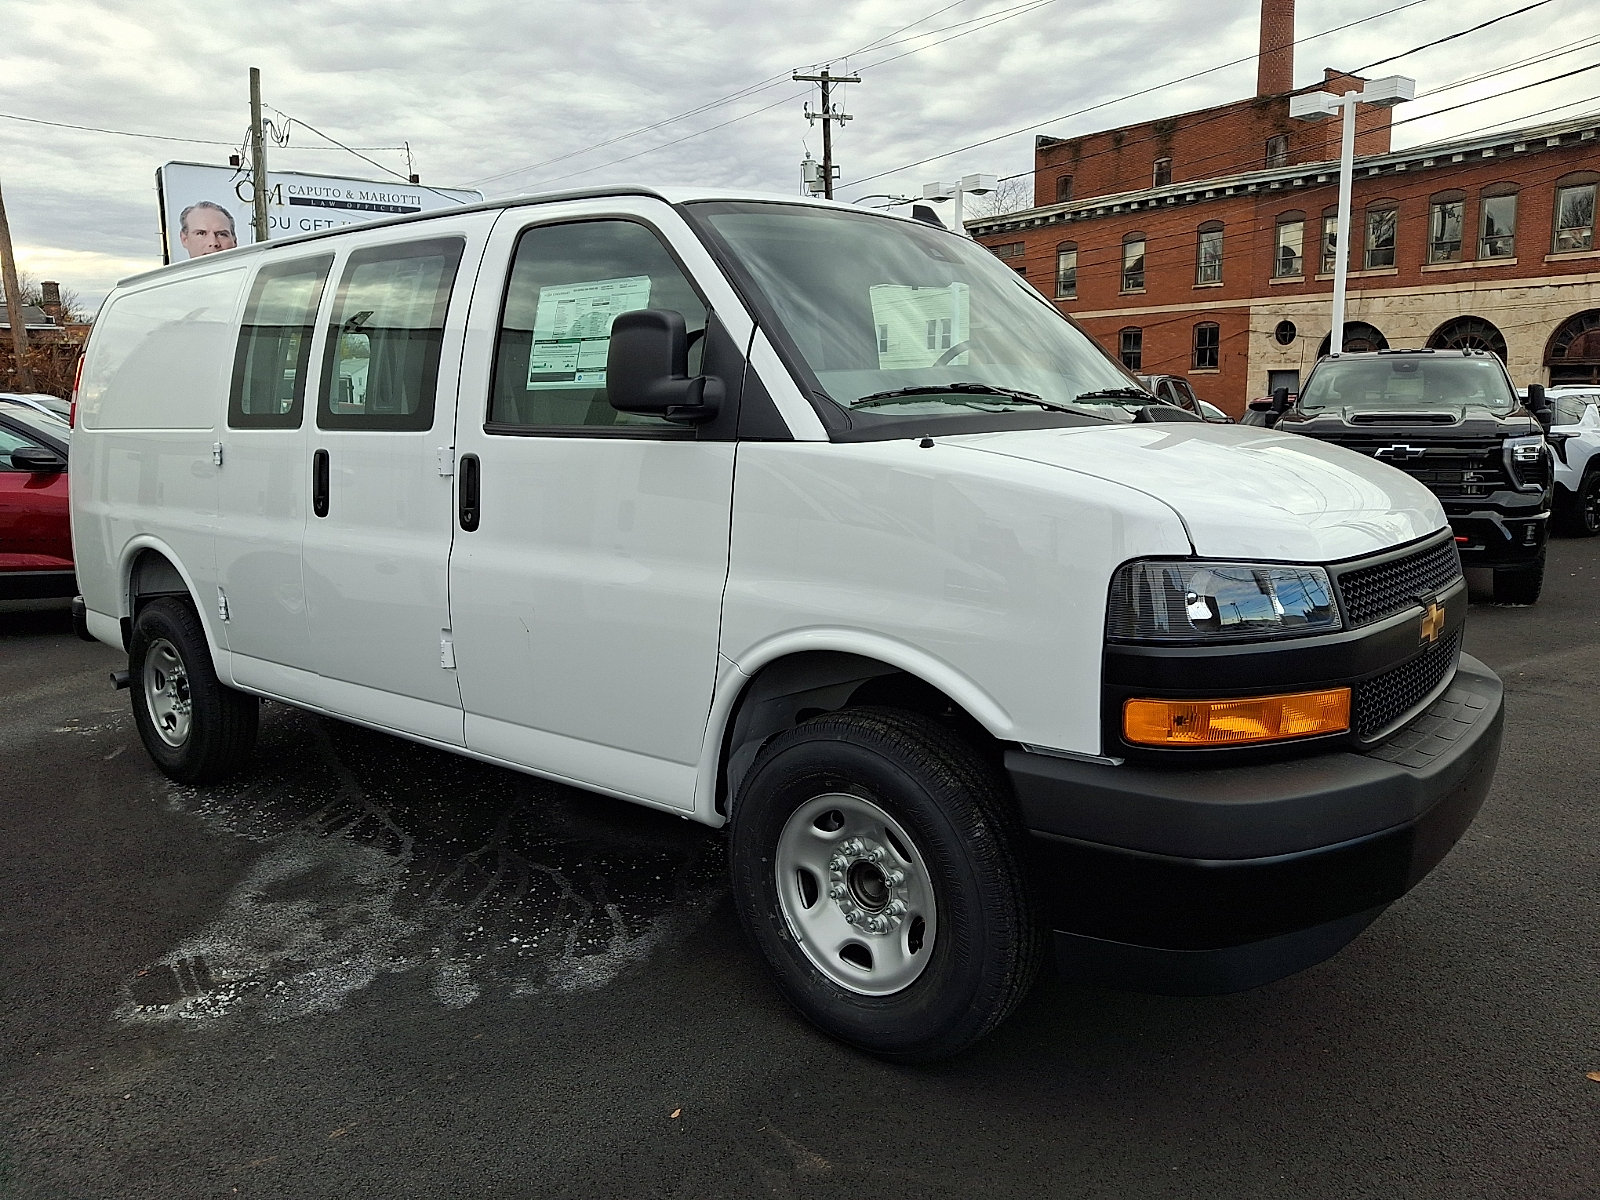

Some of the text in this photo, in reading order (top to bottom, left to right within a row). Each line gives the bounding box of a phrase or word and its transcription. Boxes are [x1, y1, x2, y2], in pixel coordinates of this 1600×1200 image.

[288, 185, 421, 205] CAPUTO & MARIOTTI
[346, 203, 402, 212] OFFICES
